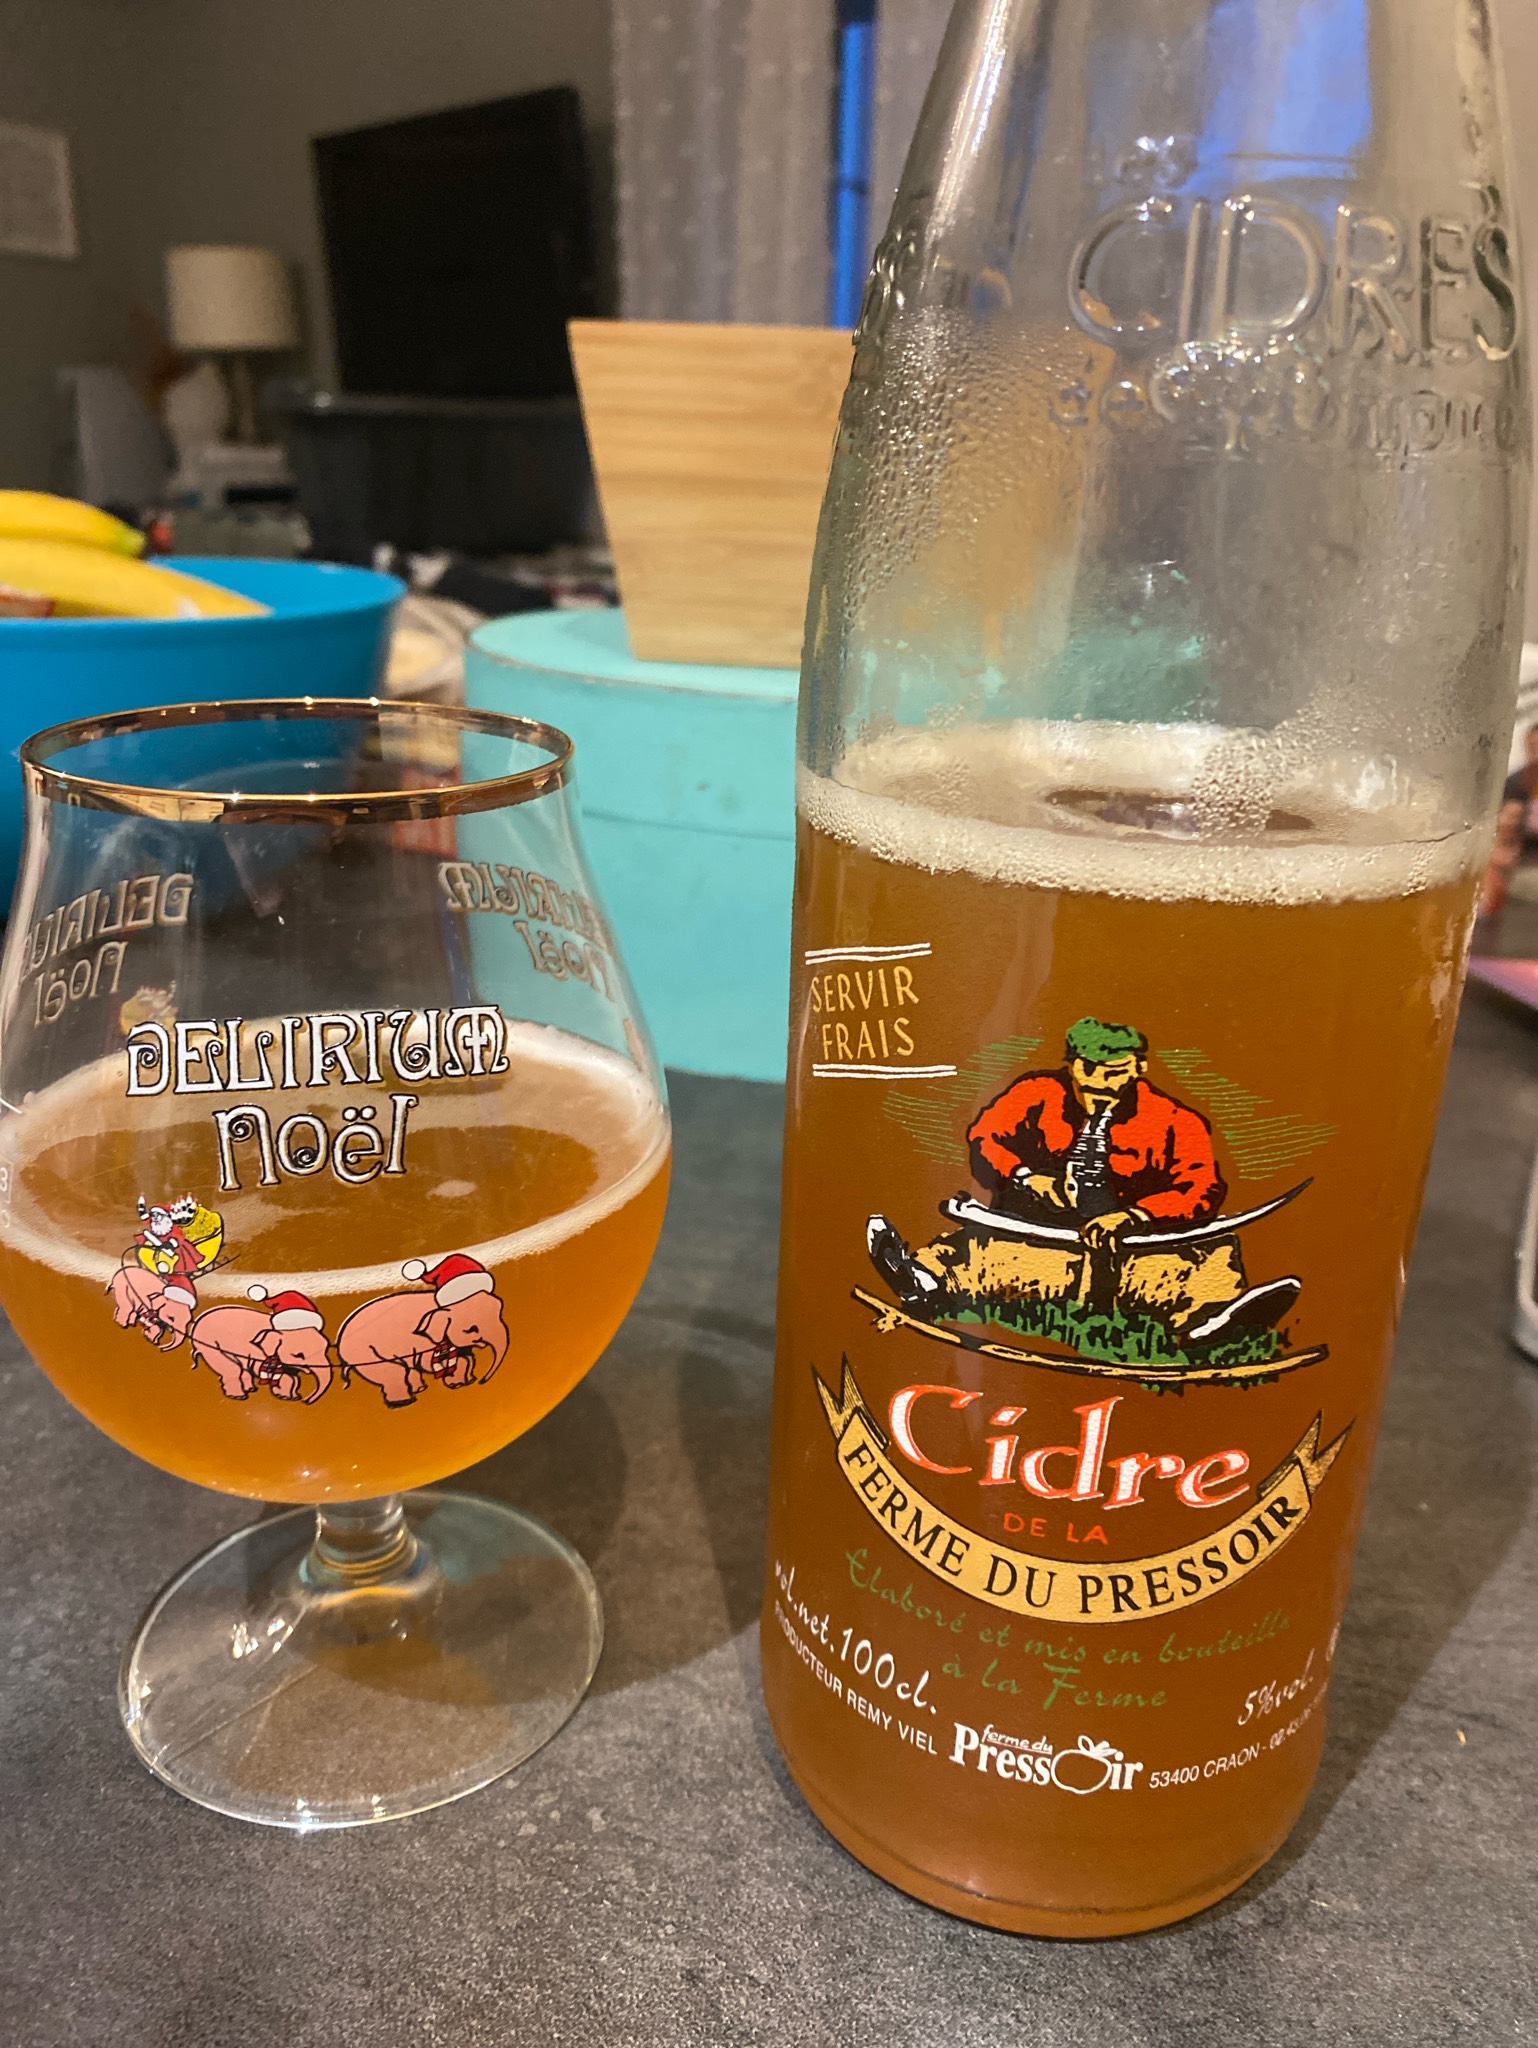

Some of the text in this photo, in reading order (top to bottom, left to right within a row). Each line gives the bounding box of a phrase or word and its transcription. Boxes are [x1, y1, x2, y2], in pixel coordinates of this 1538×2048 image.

[1068, 194, 1518, 361] CIDRES
[811, 965, 920, 1013] SERVIR
[125, 1004, 510, 1097] DELIRIUM
[822, 1017, 915, 1061] FRAIS
[888, 1384, 1251, 1510] Cidre
[843, 1438, 1301, 1614] FERME DU PRESSOIR
[1003, 1512, 1109, 1545] DE LA
[978, 1623, 1012, 1648] et
[1023, 1635, 1088, 1663] mis
[1103, 1647, 1142, 1665] en
[941, 1652, 1169, 1711] à la Ferme
[846, 1687, 893, 1732] REMY
[897, 1719, 938, 1757] VIEL
[981, 1723, 1054, 1754] ferme du
[1148, 1742, 1261, 1789] 53400 CRAON
